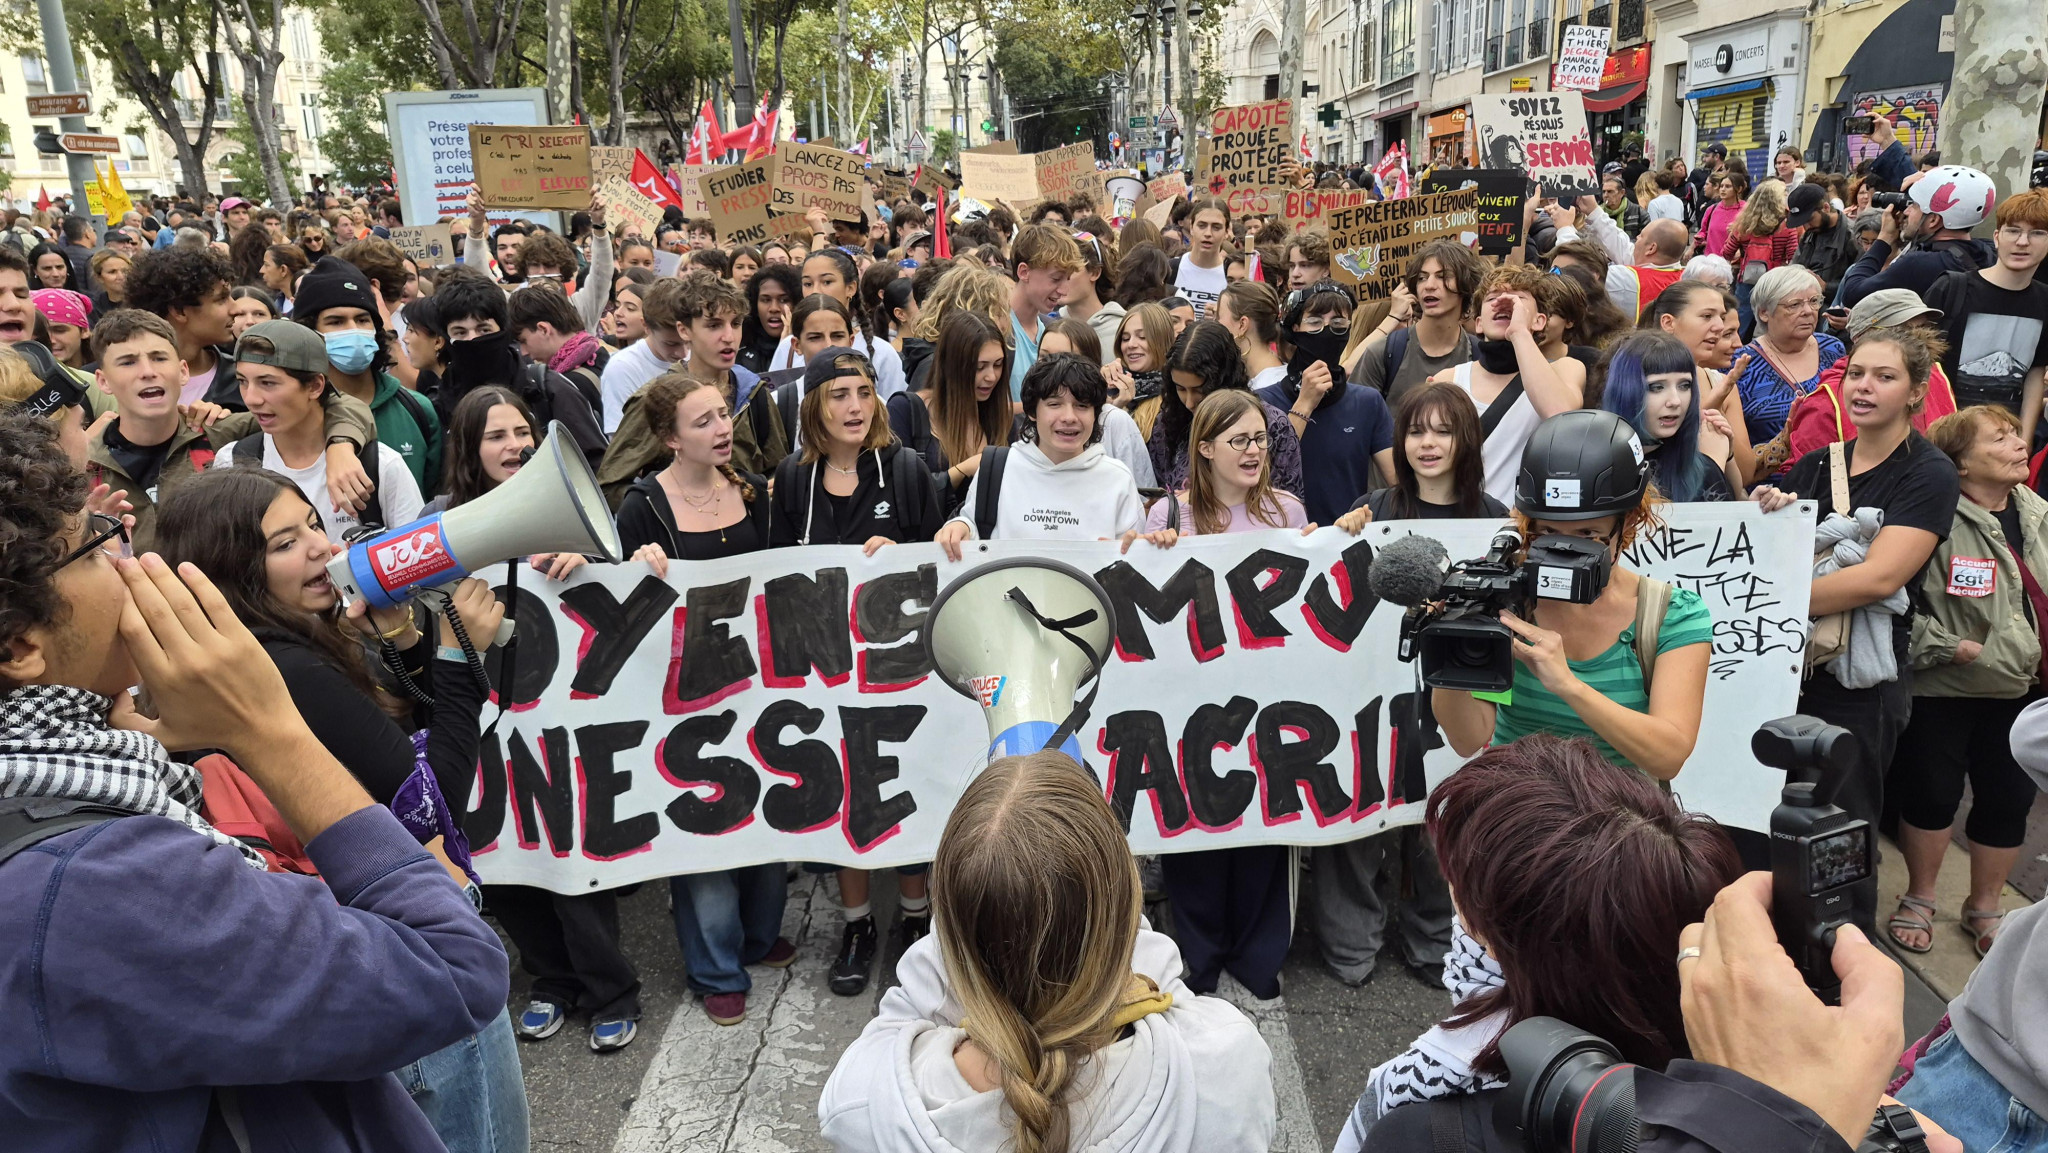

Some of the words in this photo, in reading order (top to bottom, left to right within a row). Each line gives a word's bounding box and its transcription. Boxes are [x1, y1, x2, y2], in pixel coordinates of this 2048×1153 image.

[1567, 27, 1608, 38] ADOLF
[1567, 38, 1608, 49] THIERS
[1562, 56, 1598, 65] MAURICE
[1694, 57, 1717, 69] MARSEILL
[1735, 45, 1765, 61] CONCERTS
[1562, 65, 1600, 73] PAPON
[39, 97, 72, 105] assurance
[40, 106, 66, 114] maladie
[1212, 102, 1290, 135] CAPOTE
[1523, 115, 1564, 131] RÉSOLUS
[430, 135, 464, 146] votre
[500, 134, 533, 149] TRI
[1212, 124, 1279, 151] TROUÉE
[1529, 132, 1538, 140] NE
[1541, 132, 1558, 140] PLUS
[785, 147, 843, 171] LANCEZ
[847, 160, 866, 176] DES
[435, 163, 443, 174] à
[708, 166, 767, 197] ÉTUDIER
[833, 176, 855, 193] PAS
[1228, 171, 1255, 188] QUE
[773, 188, 795, 204] DES
[801, 193, 862, 216] LACRYMOS
[1227, 187, 1270, 213] CRS
[1477, 192, 1519, 207] VIVENT
[1331, 210, 1353, 231] JE
[1391, 222, 1410, 239] LES
[1414, 214, 1443, 234] PETITE
[1445, 208, 1477, 229] SOURIS
[392, 230, 413, 238] LADY
[396, 238, 421, 248] BLUE
[1379, 247, 1390, 262] ET
[1392, 244, 1409, 260] NON
[1379, 259, 1400, 278] QUI
[1552, 487, 1560, 499] 3
[1045, 508, 1072, 518] Angeles
[1023, 514, 1080, 526] DOWNTOWN
[1706, 521, 1754, 568] LA
[1952, 557, 1996, 568] Accueil
[1540, 575, 1550, 588] 3
[1954, 574, 1984, 586] cgt
[1711, 616, 1806, 656] SSES
[1773, 831, 1796, 841] POCKET
[1826, 895, 1840, 905] OSMO
